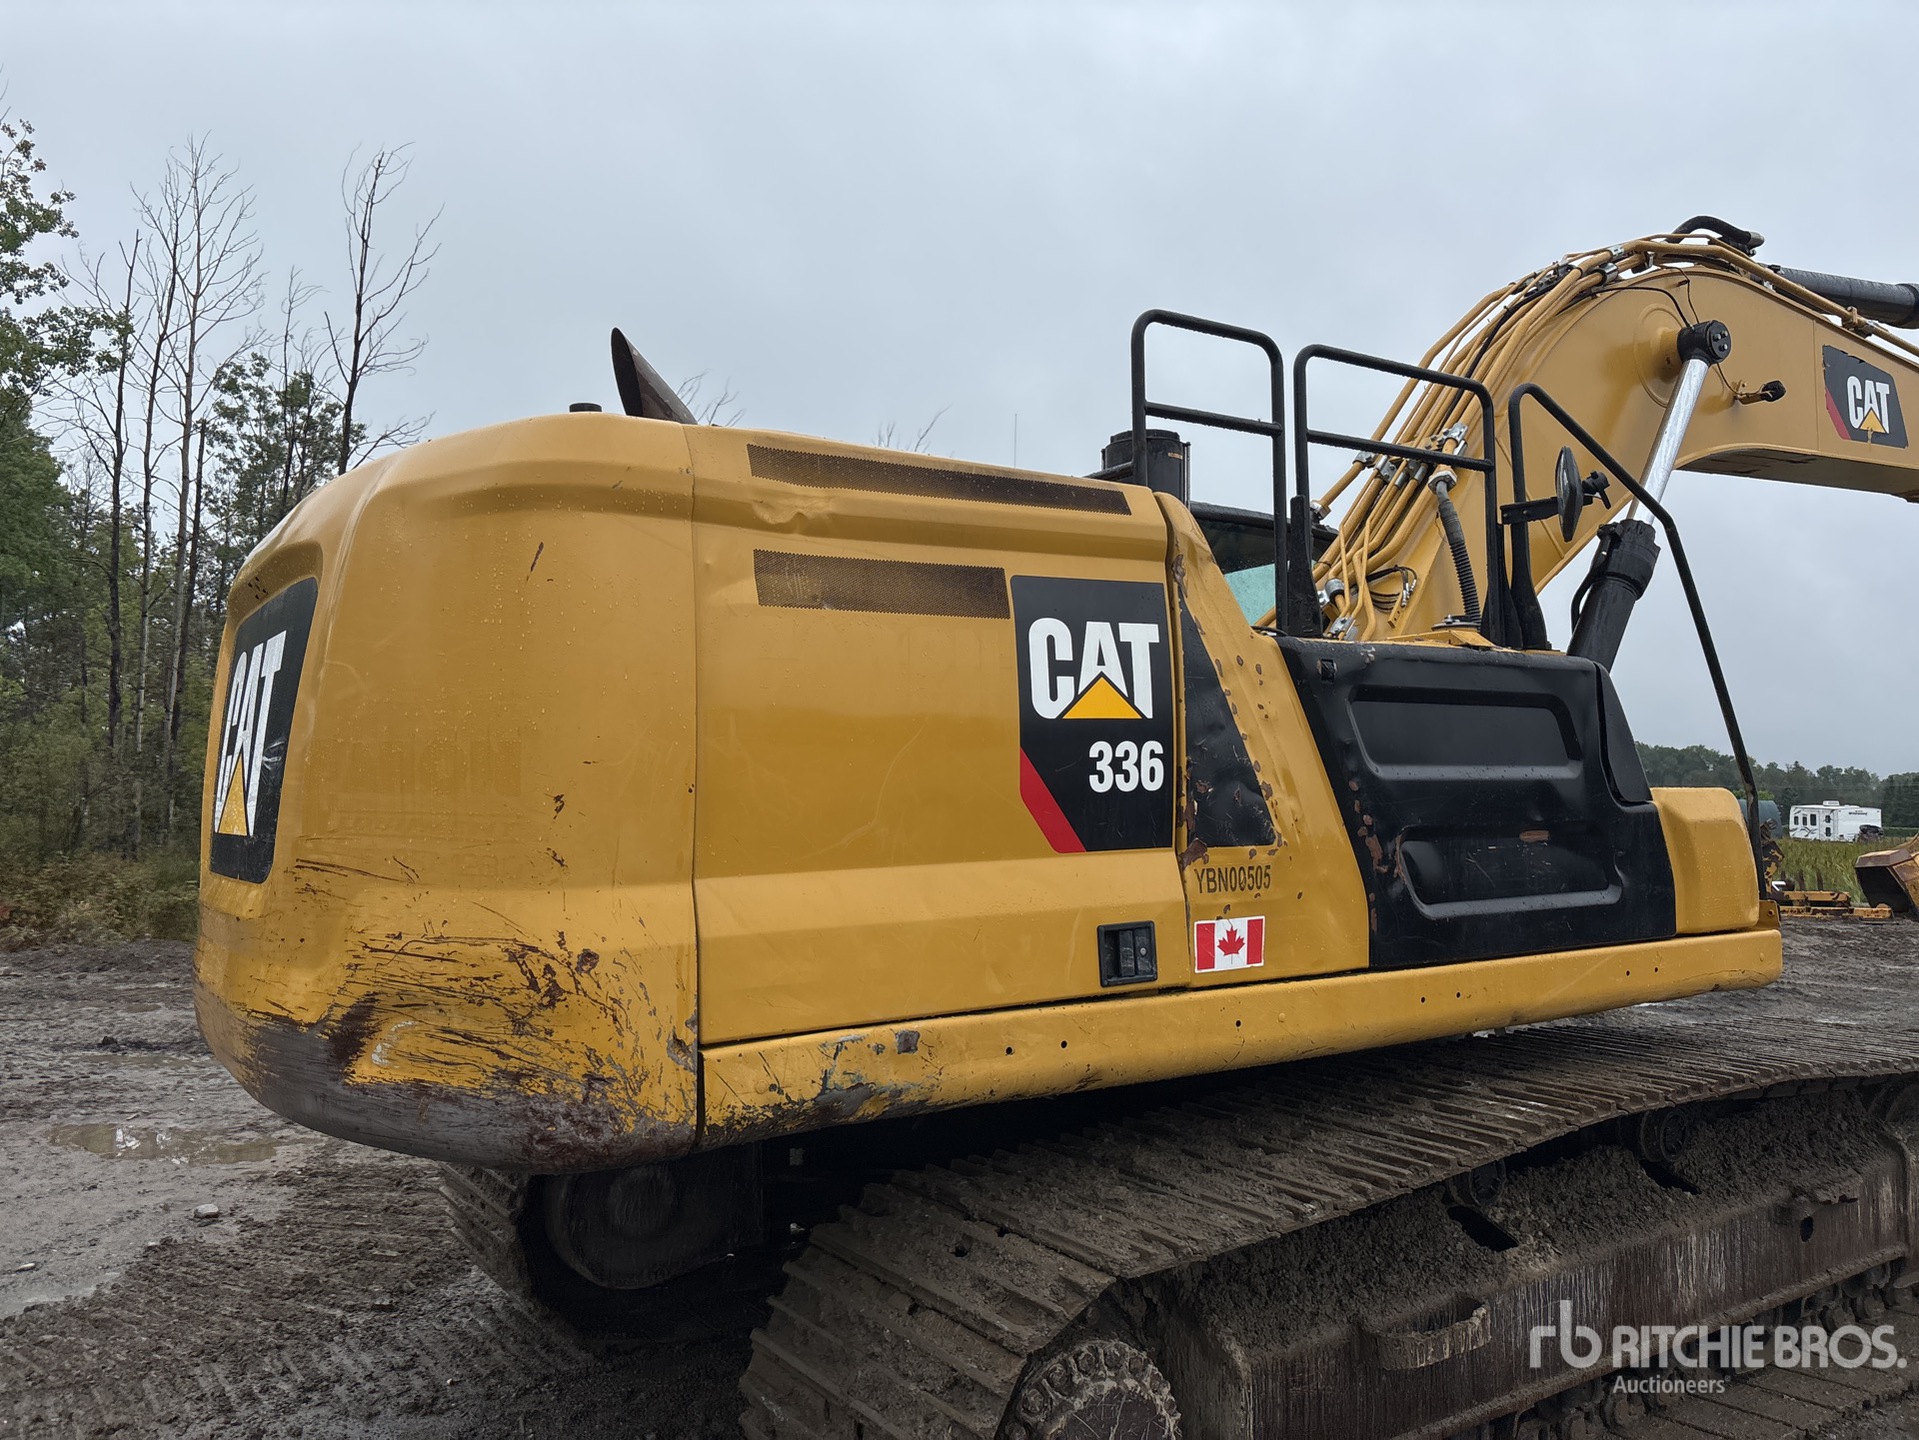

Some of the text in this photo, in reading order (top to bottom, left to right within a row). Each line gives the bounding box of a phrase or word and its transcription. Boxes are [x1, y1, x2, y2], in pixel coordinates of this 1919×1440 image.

[1847, 375, 1890, 434] CAT
[1028, 617, 1160, 719] CAT
[214, 630, 287, 837] CAT
[1088, 740, 1165, 793] 336
[1194, 865, 1271, 894] YBN00505
